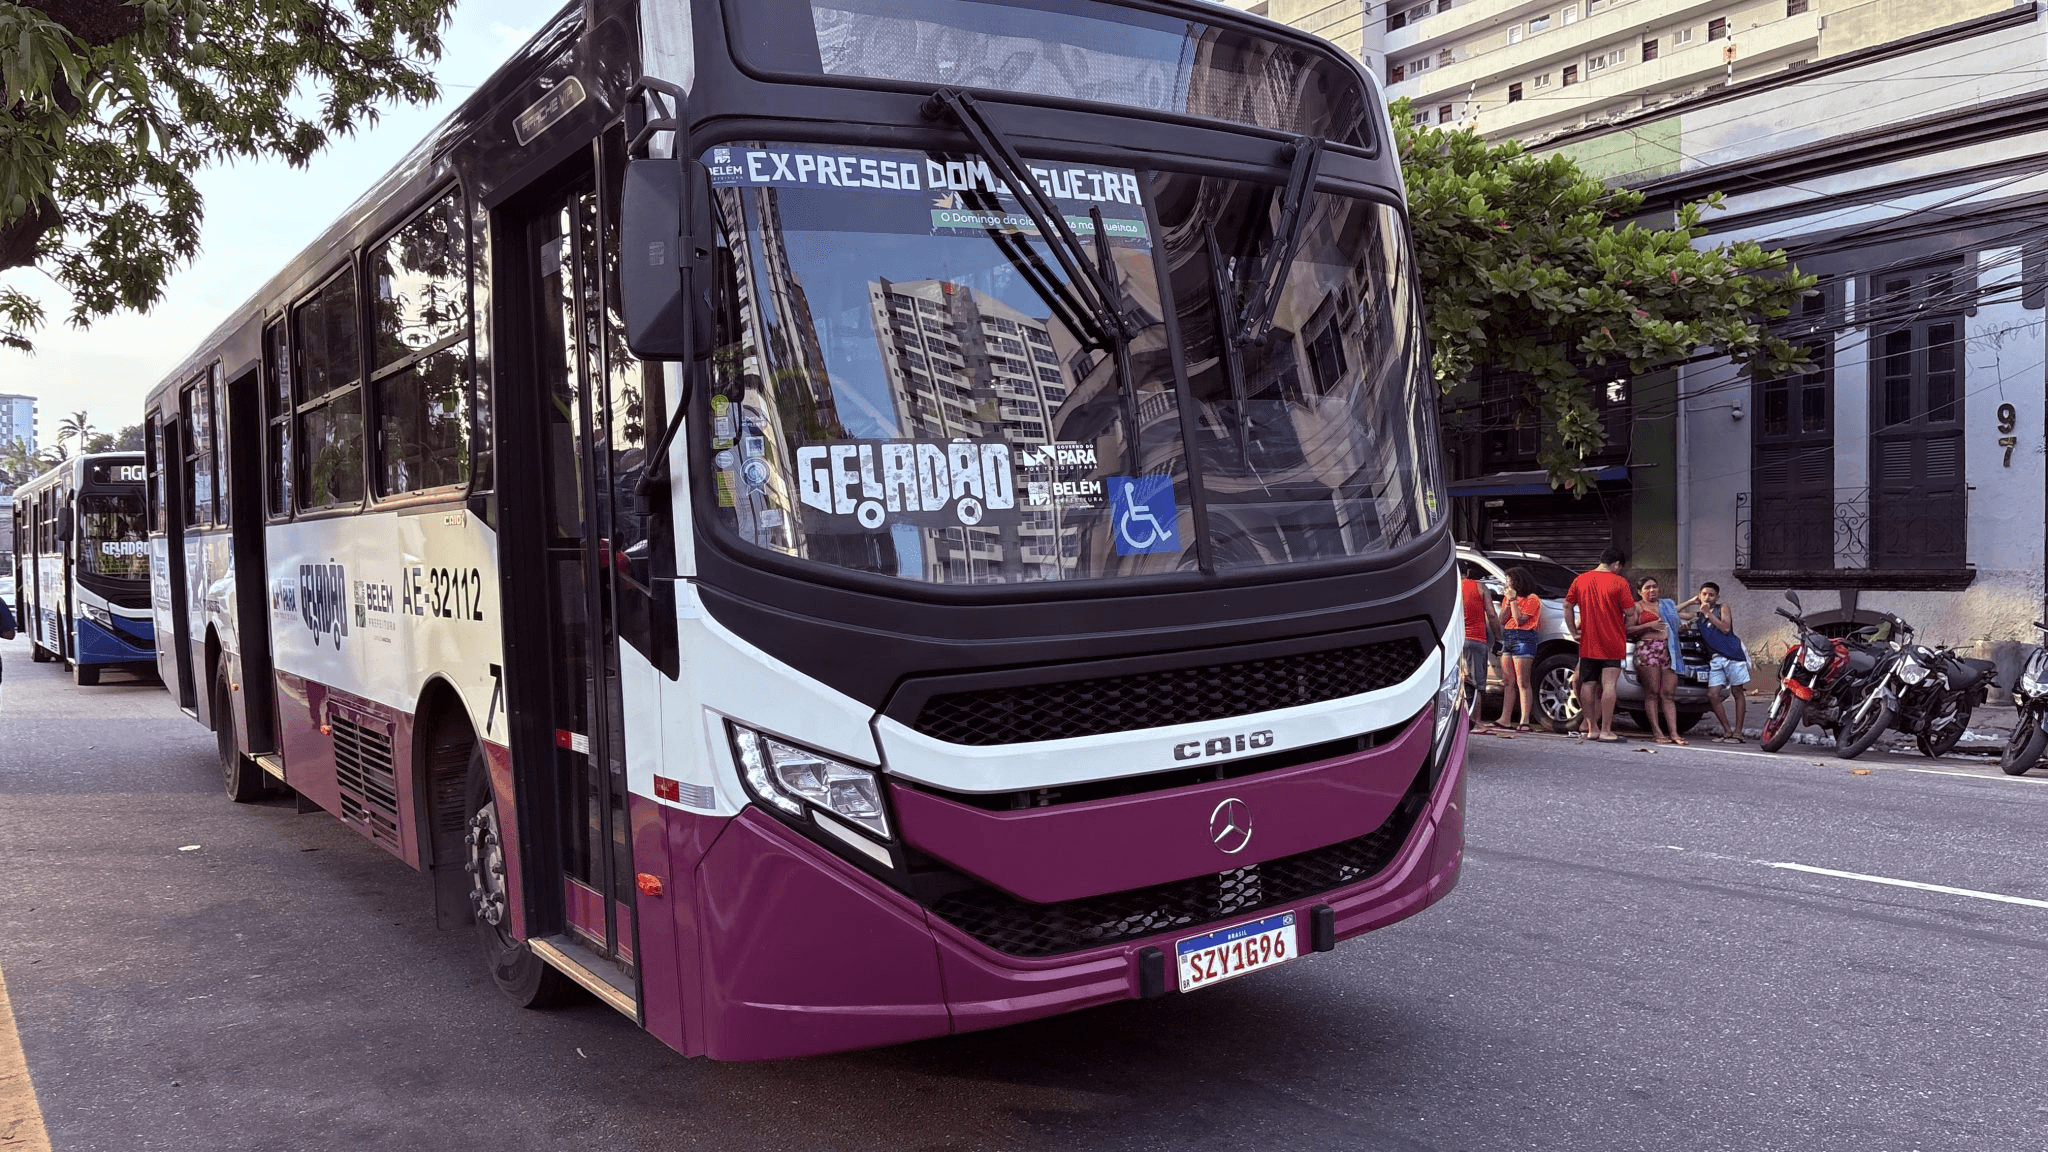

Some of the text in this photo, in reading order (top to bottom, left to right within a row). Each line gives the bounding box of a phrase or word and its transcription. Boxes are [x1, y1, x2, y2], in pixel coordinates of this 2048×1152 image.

[746, 151, 921, 190] EXPRESSO
[941, 213, 950, 221] O
[952, 213, 1000, 226] Domingo
[1003, 216, 1017, 225] da
[1078, 221, 1138, 233] maueiras
[1053, 479, 1101, 496] BELÉM
[366, 579, 394, 614] BELÉM
[402, 567, 483, 621] AE-32112
[1174, 729, 1274, 761] CAIO
[1227, 929, 1248, 941] BRASIL
[1190, 932, 1286, 982] SZY1G96
